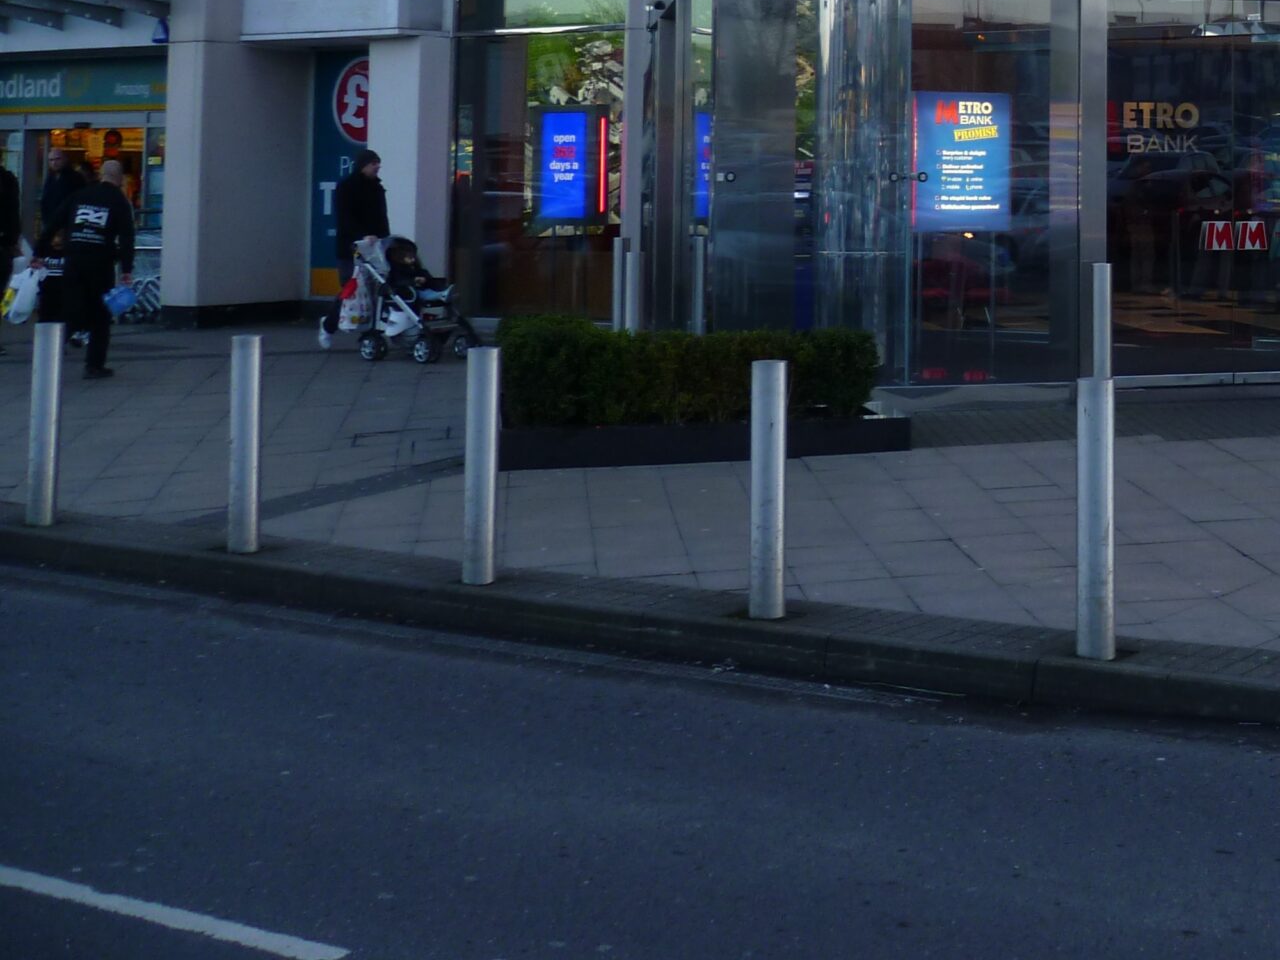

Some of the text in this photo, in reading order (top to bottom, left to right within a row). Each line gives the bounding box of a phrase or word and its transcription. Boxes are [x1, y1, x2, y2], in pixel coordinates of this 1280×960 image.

[935, 100, 993, 125] METRO
[959, 115, 993, 125] BANK
[955, 126, 998, 140] PROMISE
[553, 134, 576, 144] open
[1127, 134, 1200, 153] BANK
[549, 161, 571, 171] days
[553, 172, 575, 182] year
